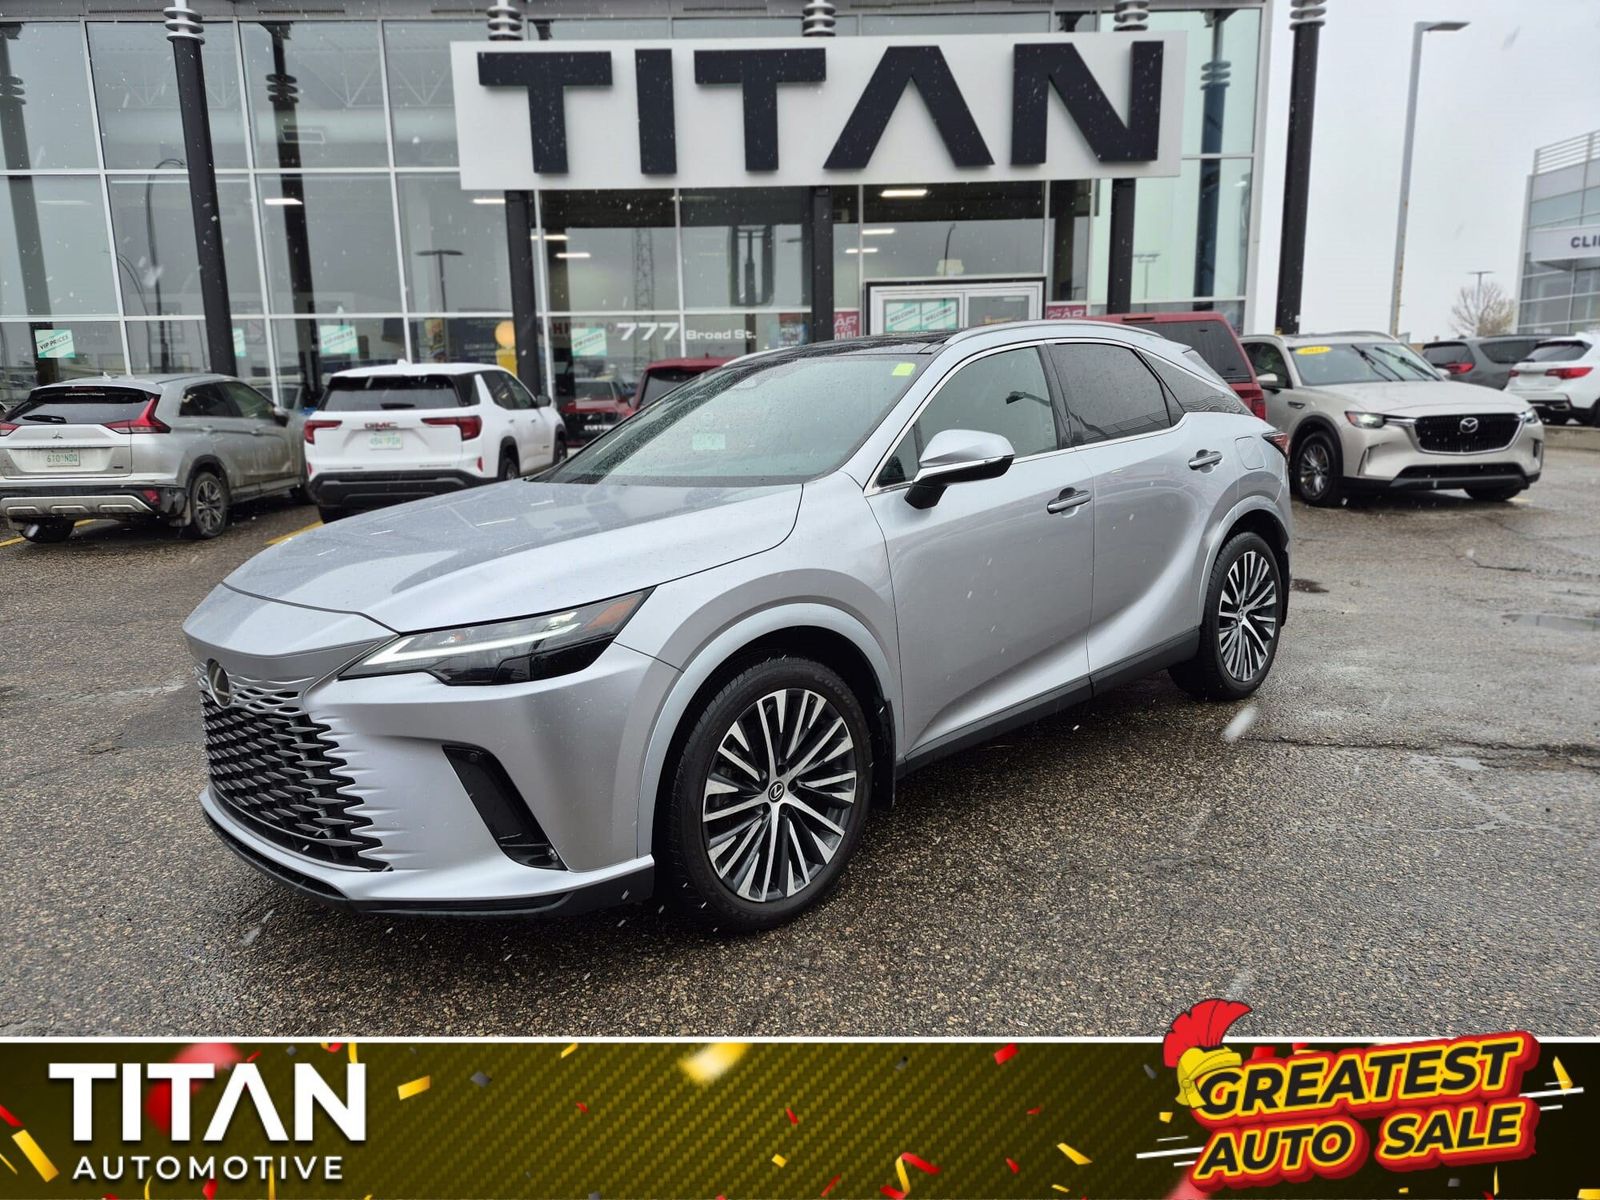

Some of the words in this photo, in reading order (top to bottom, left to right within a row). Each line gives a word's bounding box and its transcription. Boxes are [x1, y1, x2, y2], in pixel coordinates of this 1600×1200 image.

[477, 40, 1165, 174] TITAN
[616, 322, 679, 341] 777
[685, 330, 732, 341] Broad
[734, 329, 757, 340] St.
[364, 421, 399, 430] GMC
